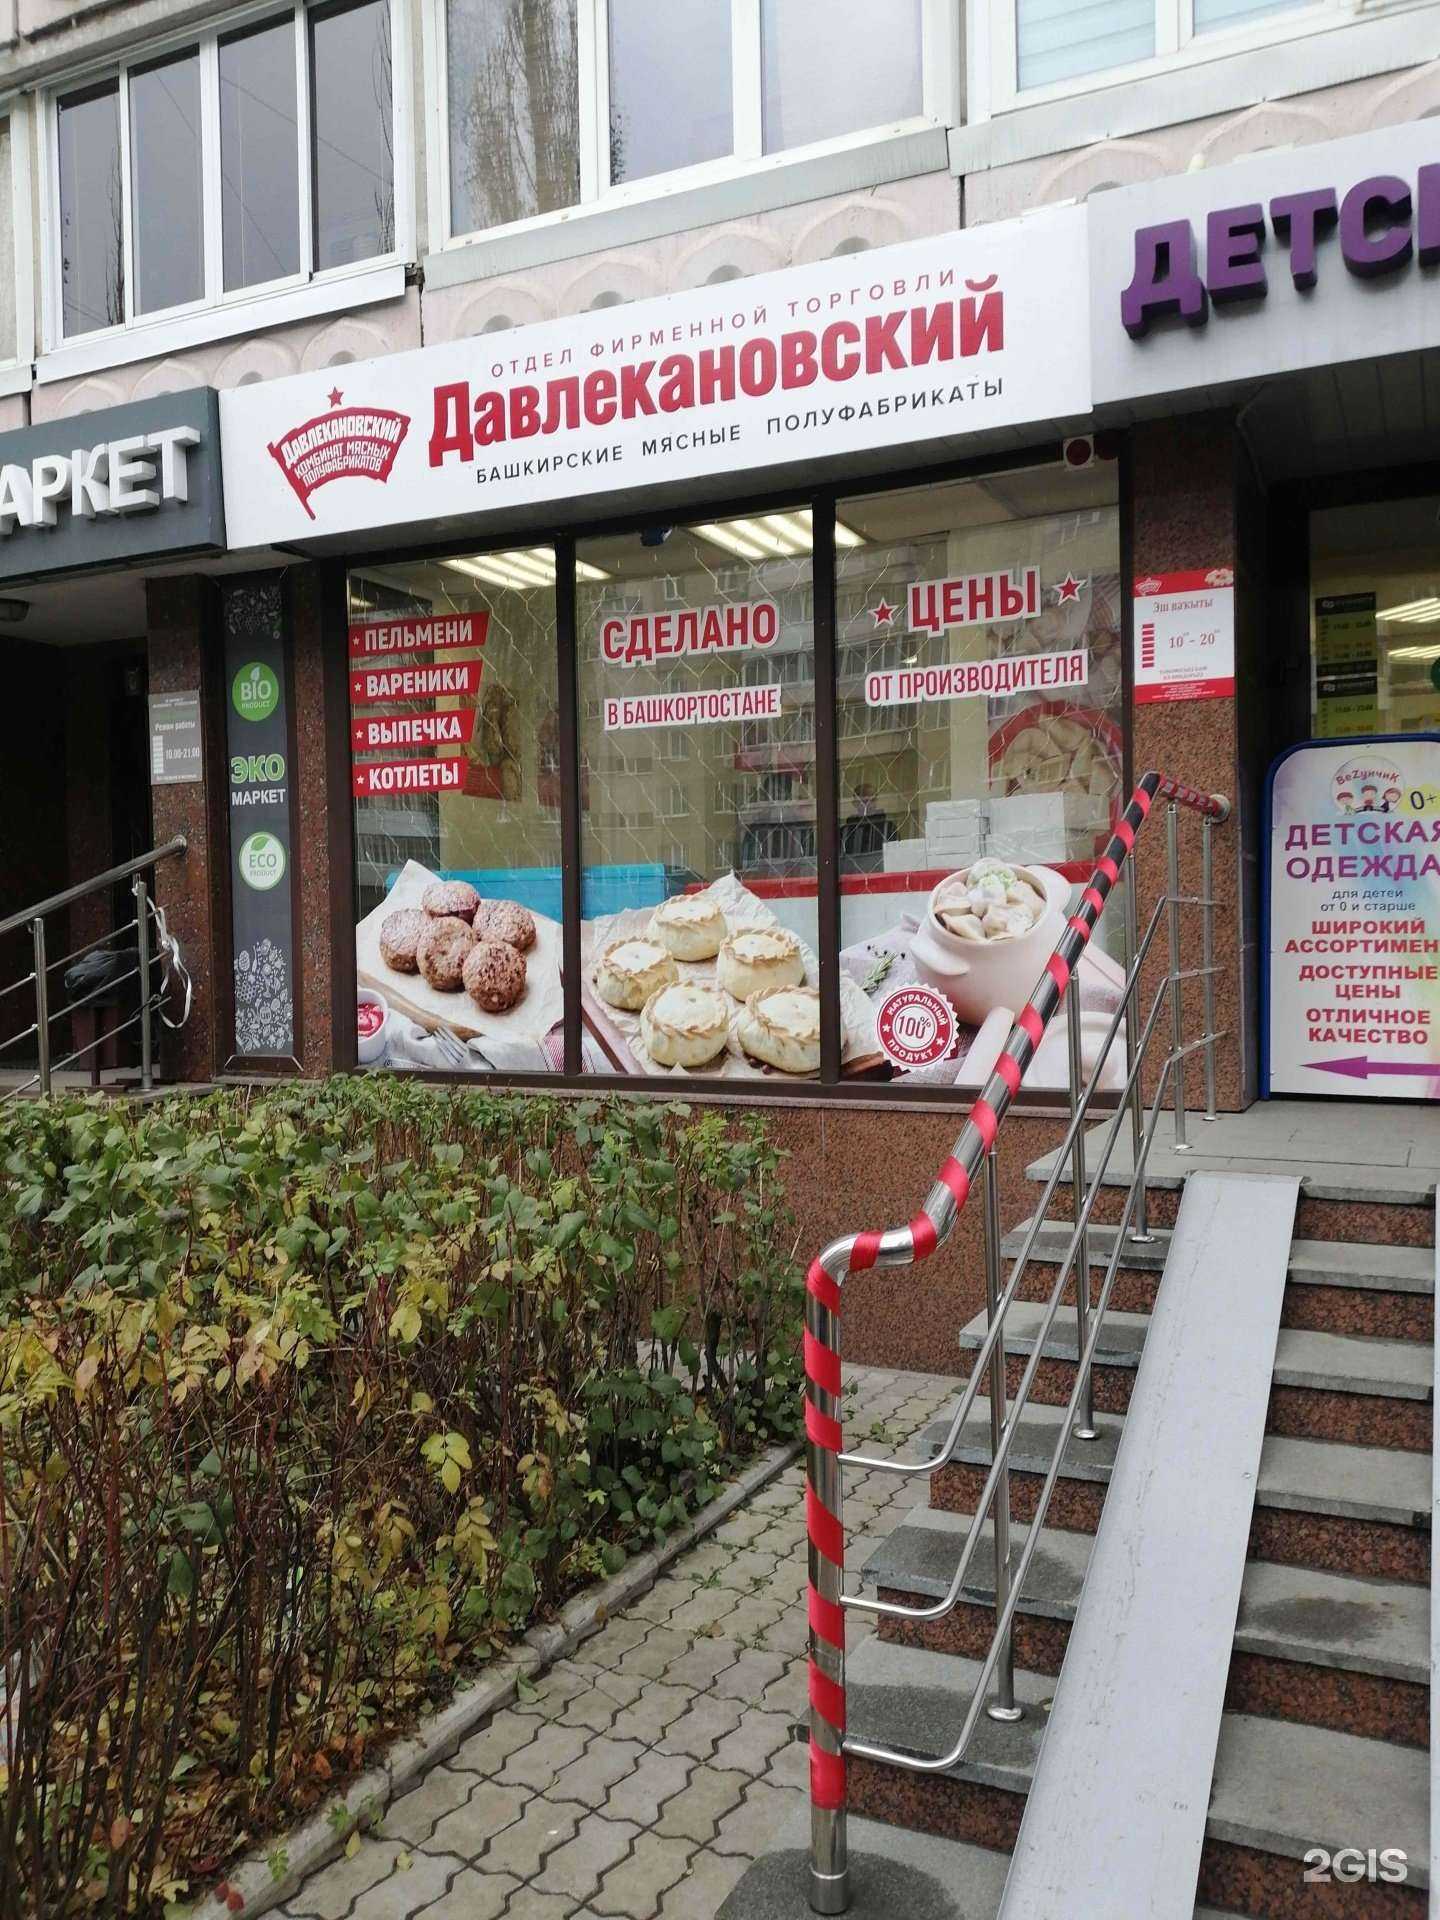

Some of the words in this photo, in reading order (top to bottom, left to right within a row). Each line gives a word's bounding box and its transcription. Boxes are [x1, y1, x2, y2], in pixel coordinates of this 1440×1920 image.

[491, 348, 572, 378] ОТДЕЛ
[590, 305, 767, 358] ФИРМЕННОЙ
[787, 269, 957, 319] ТОРГОВЛИ
[429, 274, 1004, 467] Давлекановский
[281, 415, 402, 469] ДАВЛЕКАНОВСКИЙ
[476, 445, 623, 483] БАШКИРСКИЕ
[642, 424, 741, 456] МЯСНЫЕ
[767, 377, 1003, 435] ПОЛУФАБРИКАТЫ
[294, 442, 344, 479] КОМБИНАТ
[346, 441, 391, 460] МЯСНЫХ
[302, 455, 382, 487] ПОЛУФАБРИКАТОВ
[911, 570, 1036, 632] ЦЕНЫ
[365, 619, 472, 651] ПЕЛЬМЕНИ
[603, 604, 776, 663] СДЕЛАНО
[240, 681, 272, 702] BIO
[367, 667, 469, 697] ВАРЕНИКИ
[869, 675, 892, 701] ОТ
[899, 655, 1083, 698] ПРОИЗВОДИТЕЛЯ
[608, 703, 618, 725] В
[623, 689, 777, 725] БАШКОРТОСТАНЕ
[368, 716, 462, 745] ВЫПЕЧКА
[231, 753, 285, 784] ЭКО
[369, 762, 459, 790] КОТЛЕТЫ
[231, 788, 286, 806] МАРКЕТ
[1410, 790, 1437, 810] 0+
[249, 853, 277, 869] ECO
[1286, 853, 1440, 883] ОДЕЖДА
[1320, 903, 1336, 912] от
[1339, 901, 1347, 912] 0
[1352, 903, 1360, 911] и
[1364, 902, 1416, 913] старше
[1332, 890, 1358, 900] для
[1312, 917, 1425, 935] ШИРОКИЙ
[1285, 939, 1440, 954] АССОРТИМЕН
[1299, 965, 1438, 981] ДОСТУПНЫЕ
[1335, 984, 1401, 1000] ЦЕНЫ
[887, 994, 948, 1026] НАТУРАЛЬНЫЙ
[1306, 1008, 1431, 1024] ОТЛИЧНОЕ
[888, 1040, 933, 1062] ПРОДУКТ
[1309, 1028, 1429, 1045] КАЧЕСТВО
